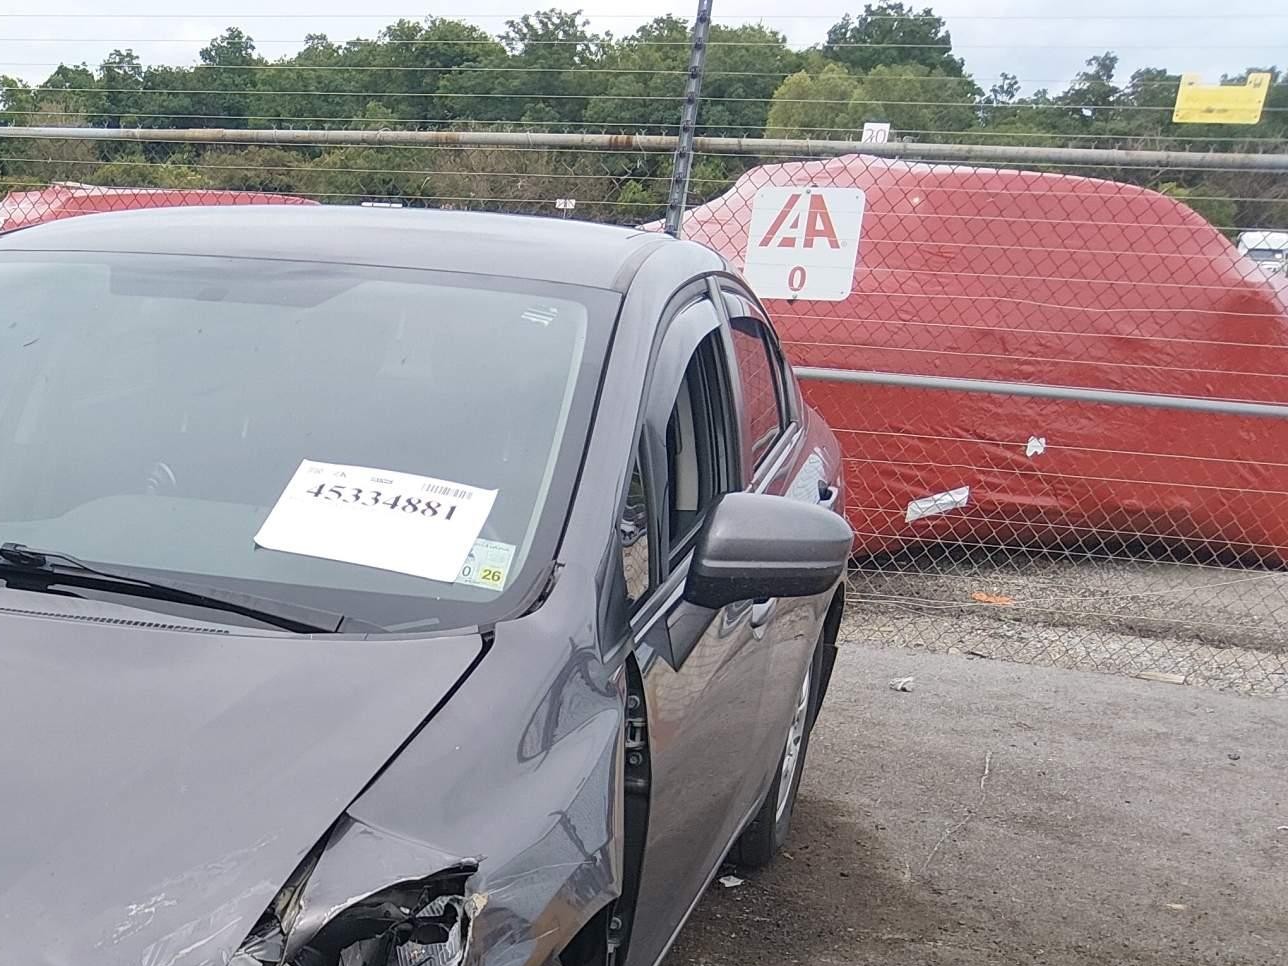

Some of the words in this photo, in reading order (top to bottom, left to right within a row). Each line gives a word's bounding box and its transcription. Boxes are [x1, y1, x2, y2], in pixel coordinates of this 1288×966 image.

[863, 129, 887, 144] 20
[787, 266, 807, 292] 0
[305, 482, 457, 521] 45334881
[481, 568, 502, 582] 26
